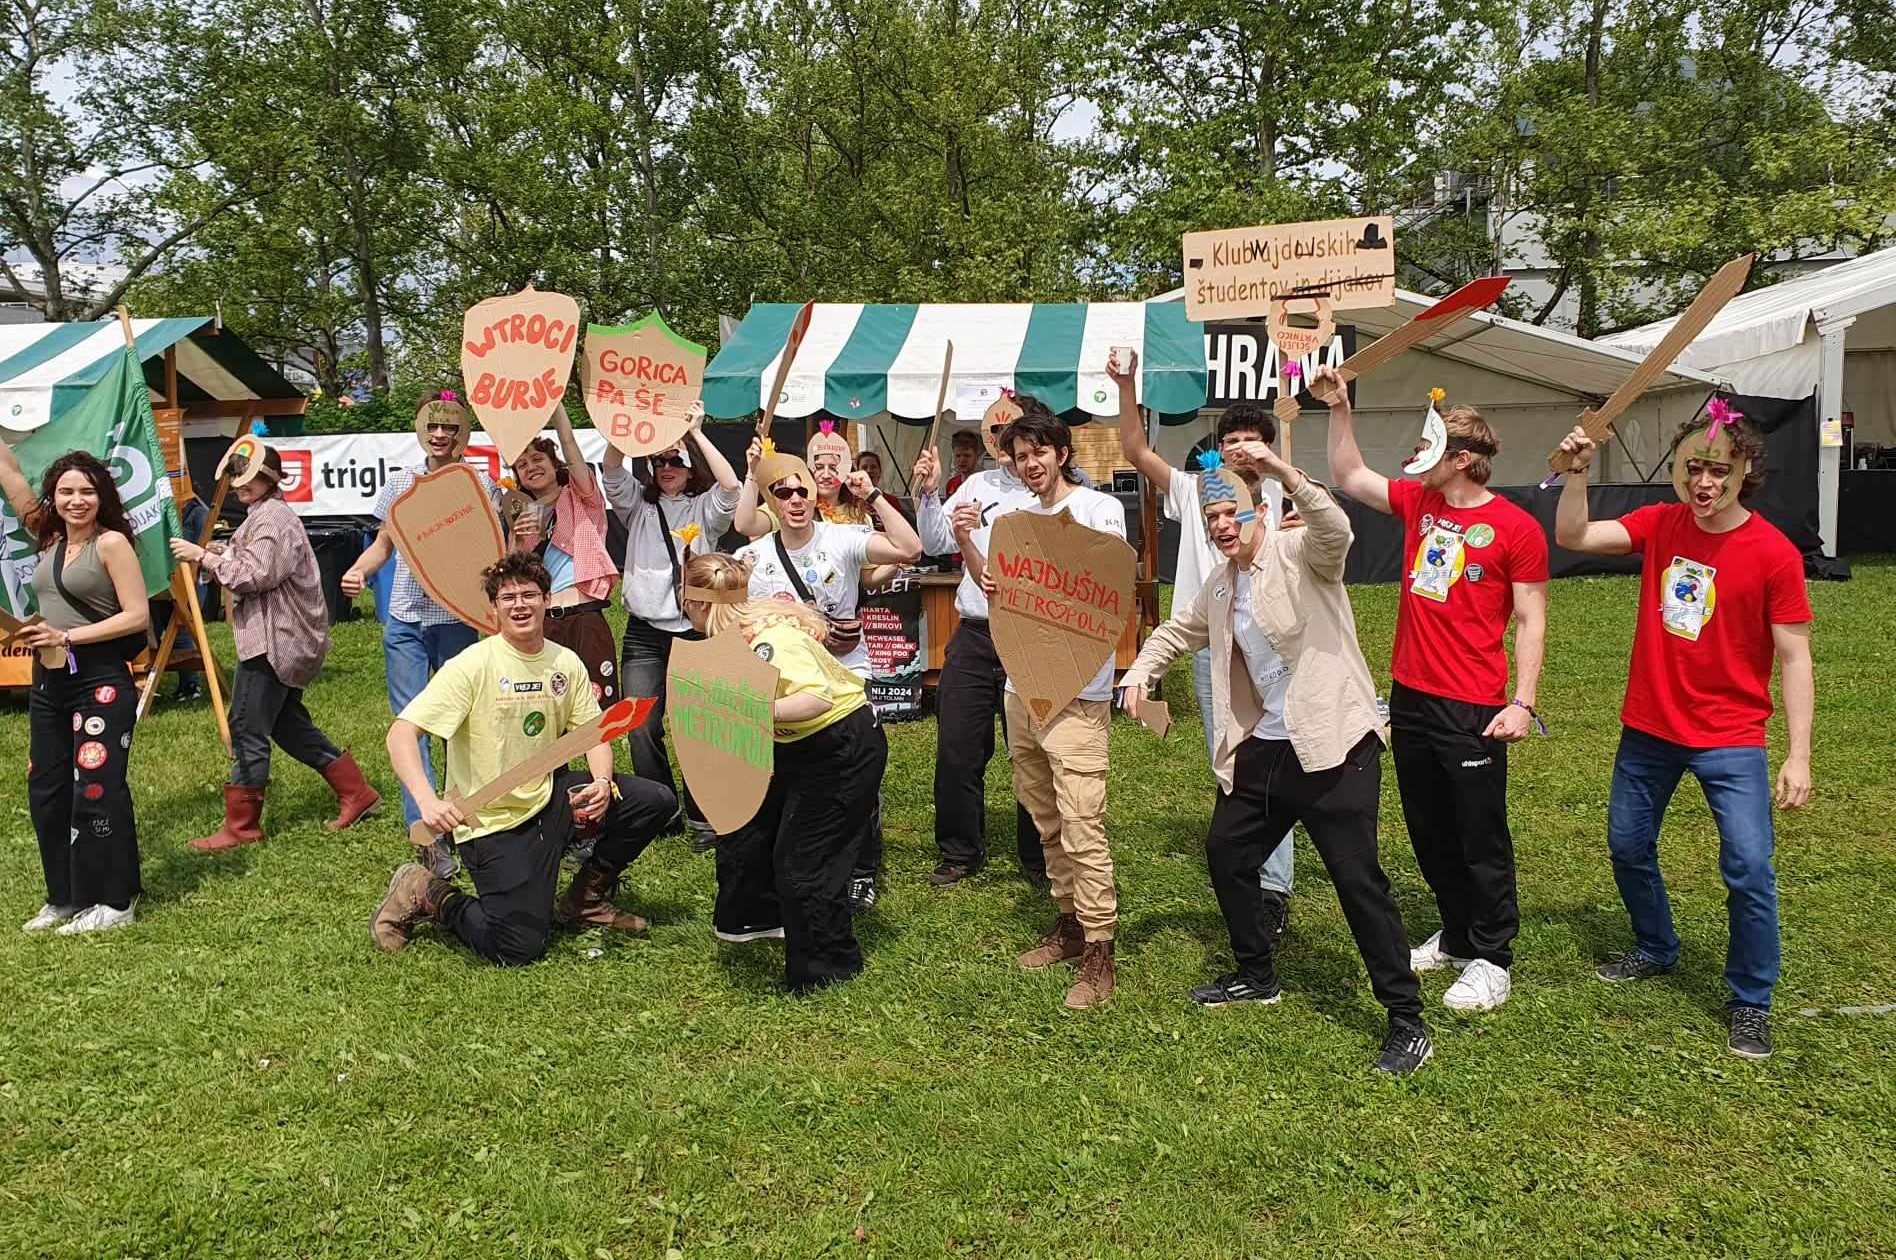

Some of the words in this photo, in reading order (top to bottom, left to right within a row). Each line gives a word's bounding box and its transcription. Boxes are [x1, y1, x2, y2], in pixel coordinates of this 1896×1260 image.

[1212, 238, 1253, 268] Klub
[1197, 275, 1288, 304] študentov
[465, 313, 576, 358] WTROCI
[599, 349, 688, 385] GORICA
[470, 367, 565, 411] BURJE
[596, 379, 625, 407] PA
[634, 382, 666, 416] ŠE
[610, 413, 656, 444] BO
[320, 457, 404, 498] trigl
[998, 551, 1120, 616] WAJDUŠNA
[887, 687, 912, 696] 2024
